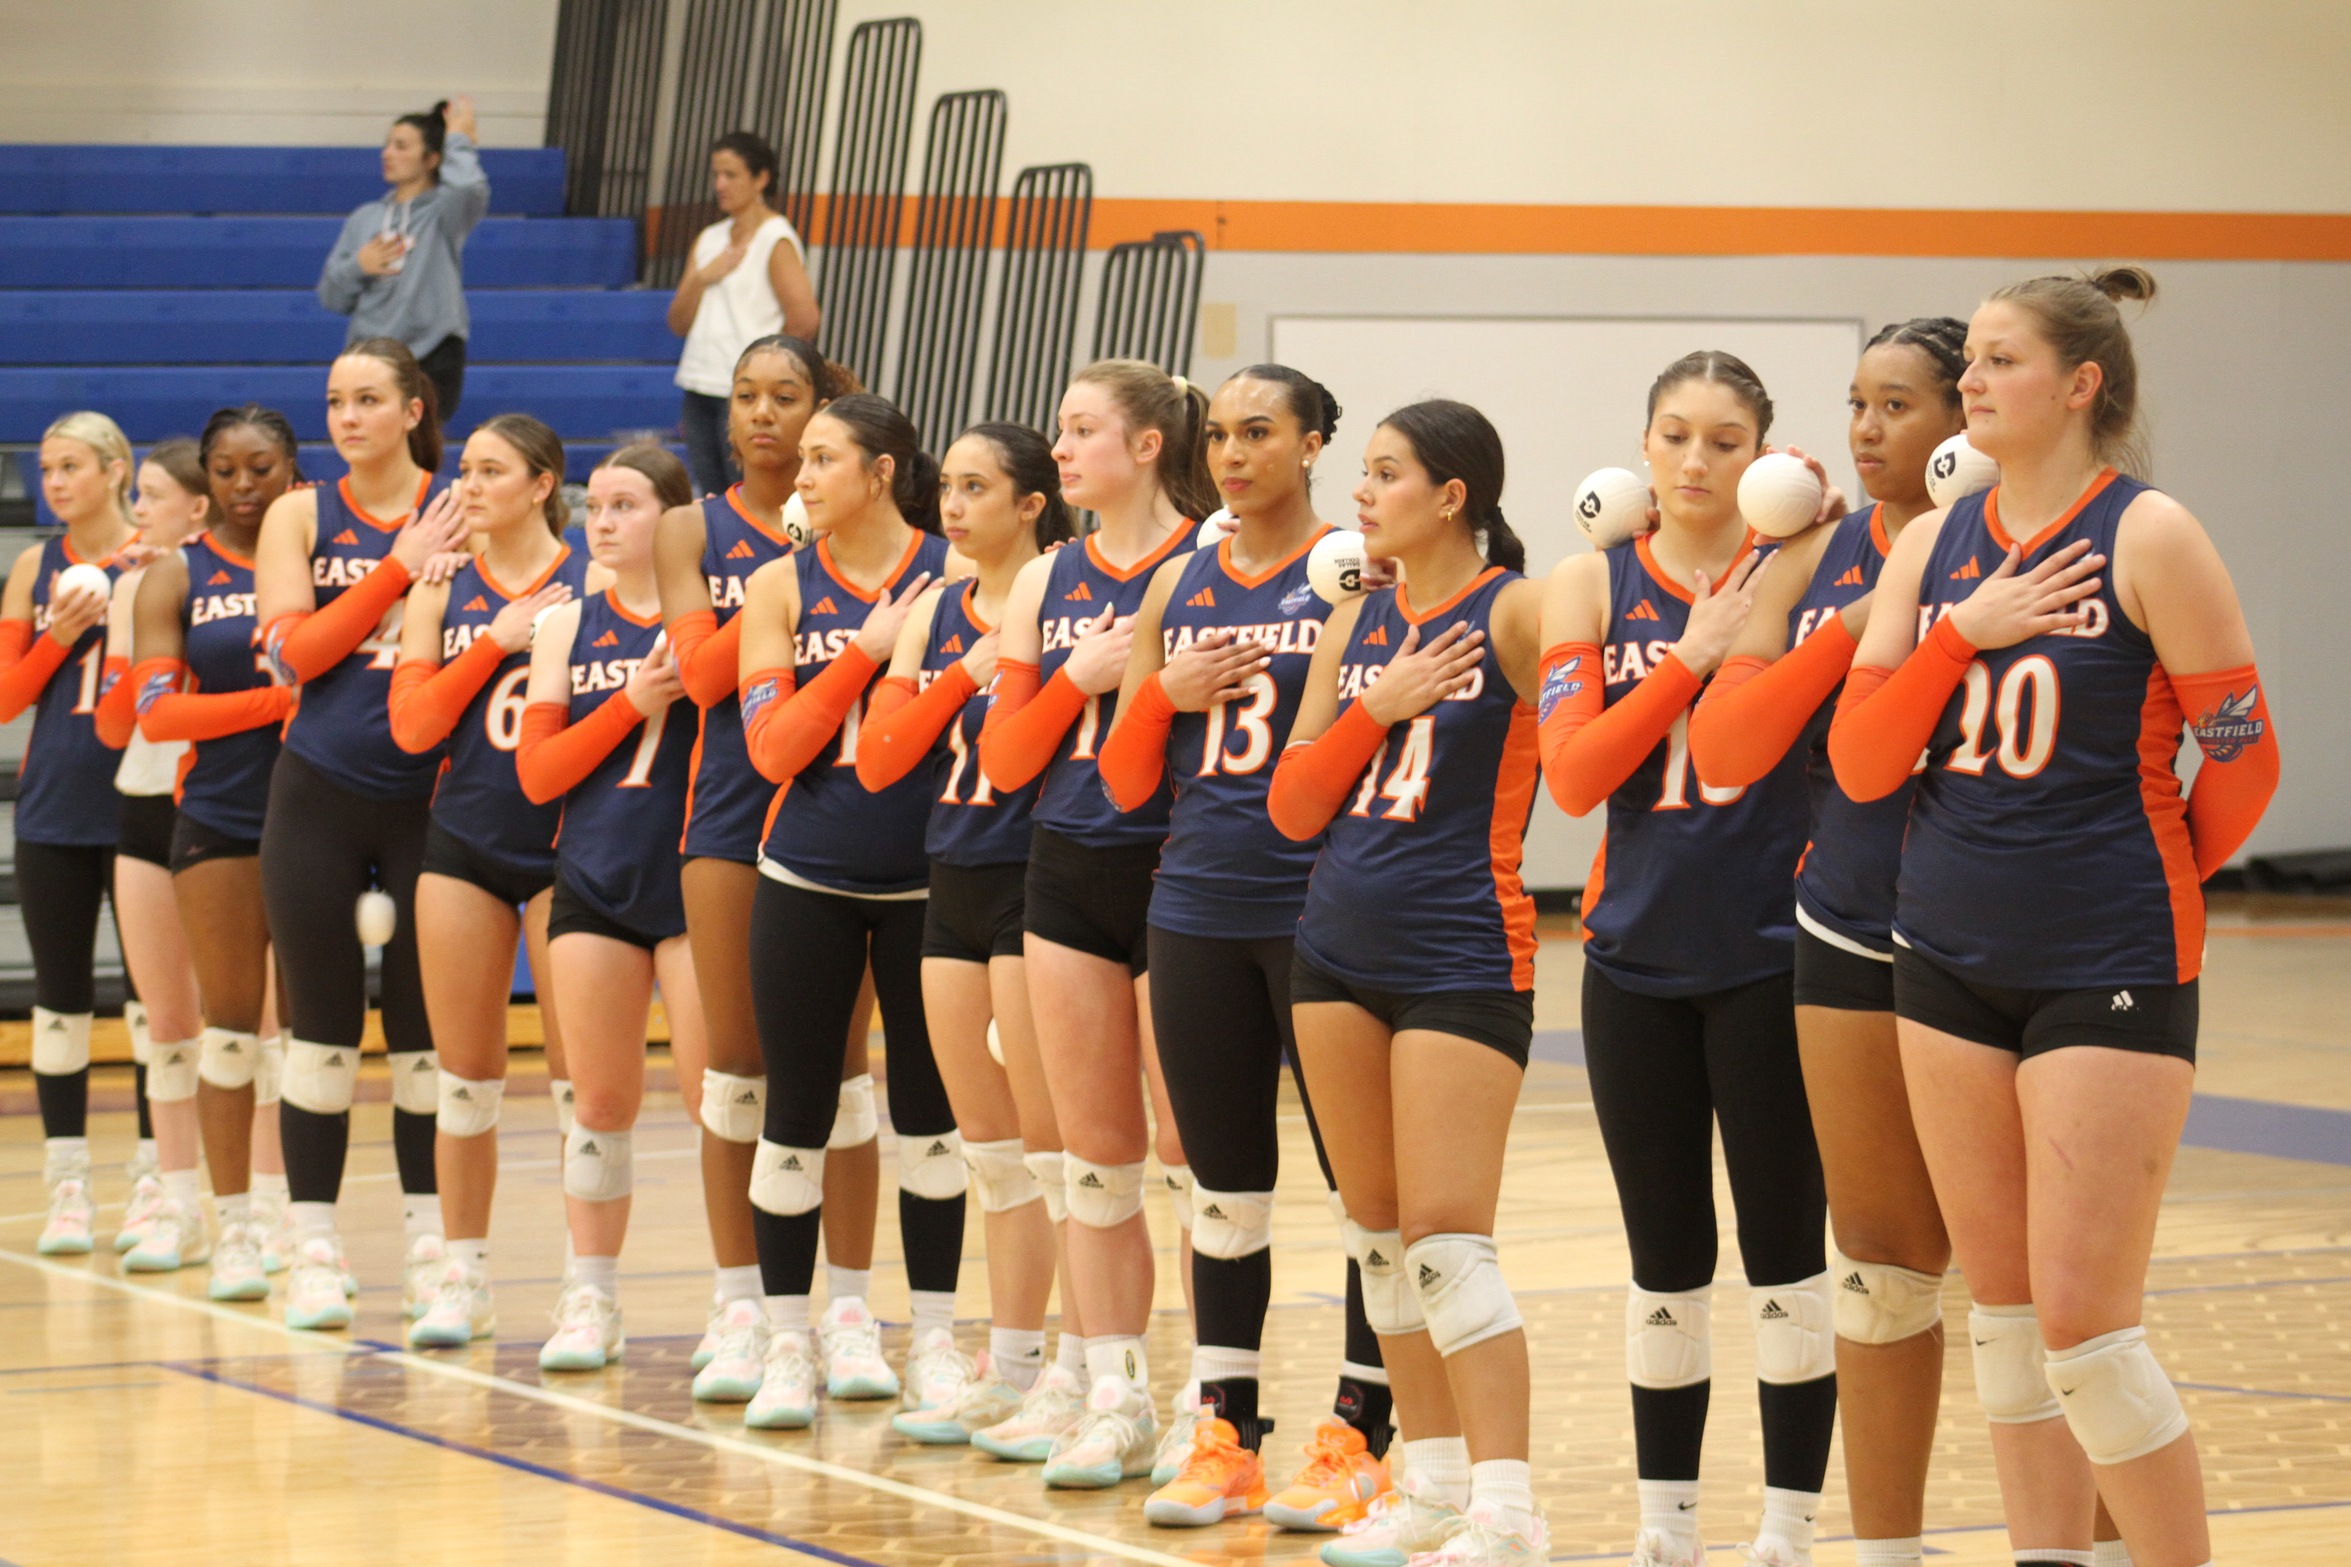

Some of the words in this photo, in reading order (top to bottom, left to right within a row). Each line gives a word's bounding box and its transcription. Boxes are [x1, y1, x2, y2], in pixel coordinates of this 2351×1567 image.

[192, 593, 257, 627] EAST
[484, 664, 531, 752] 6
[1195, 670, 1278, 777] 13
[1943, 654, 2061, 779] 20
[2192, 720, 2263, 738] EASTFIELD
[1348, 715, 1436, 823] 14
[1645, 1318, 1678, 1326] adidas
